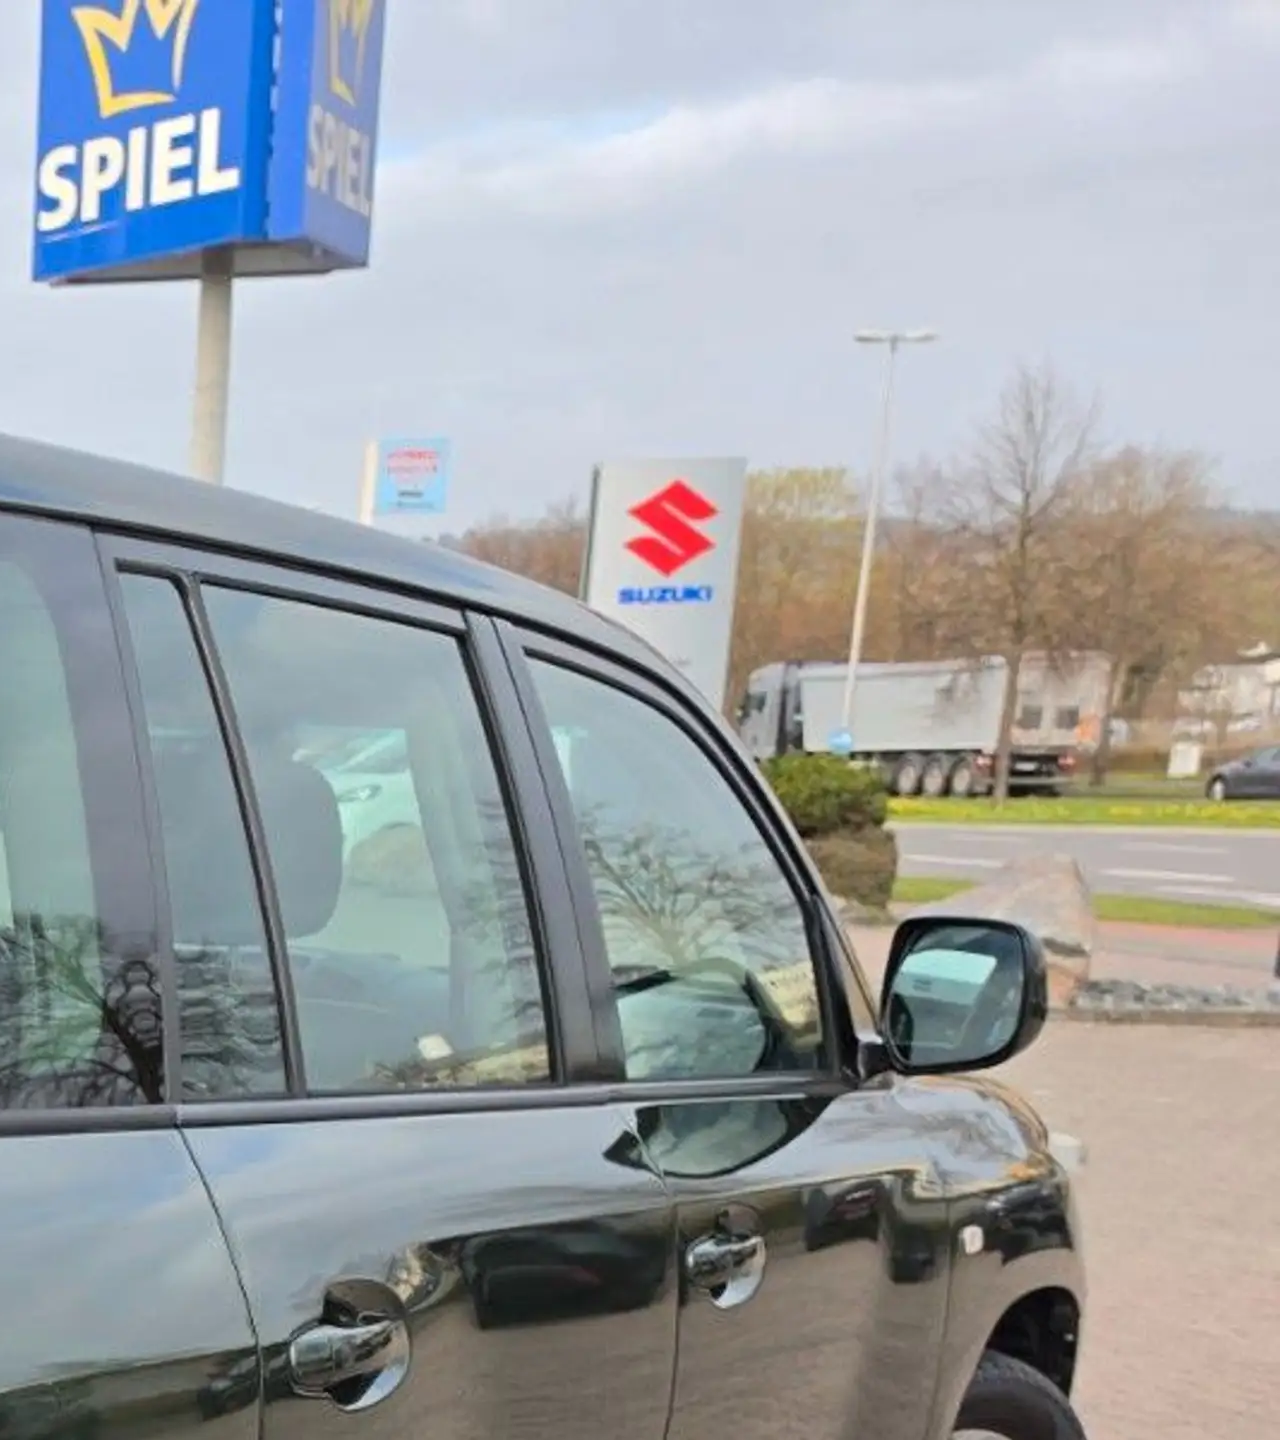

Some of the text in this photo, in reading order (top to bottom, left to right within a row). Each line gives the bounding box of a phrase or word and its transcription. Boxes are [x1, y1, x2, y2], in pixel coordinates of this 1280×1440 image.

[37, 107, 240, 231] SPIEL
[306, 104, 371, 217] SPIEL
[618, 586, 712, 605] SUZUKI
